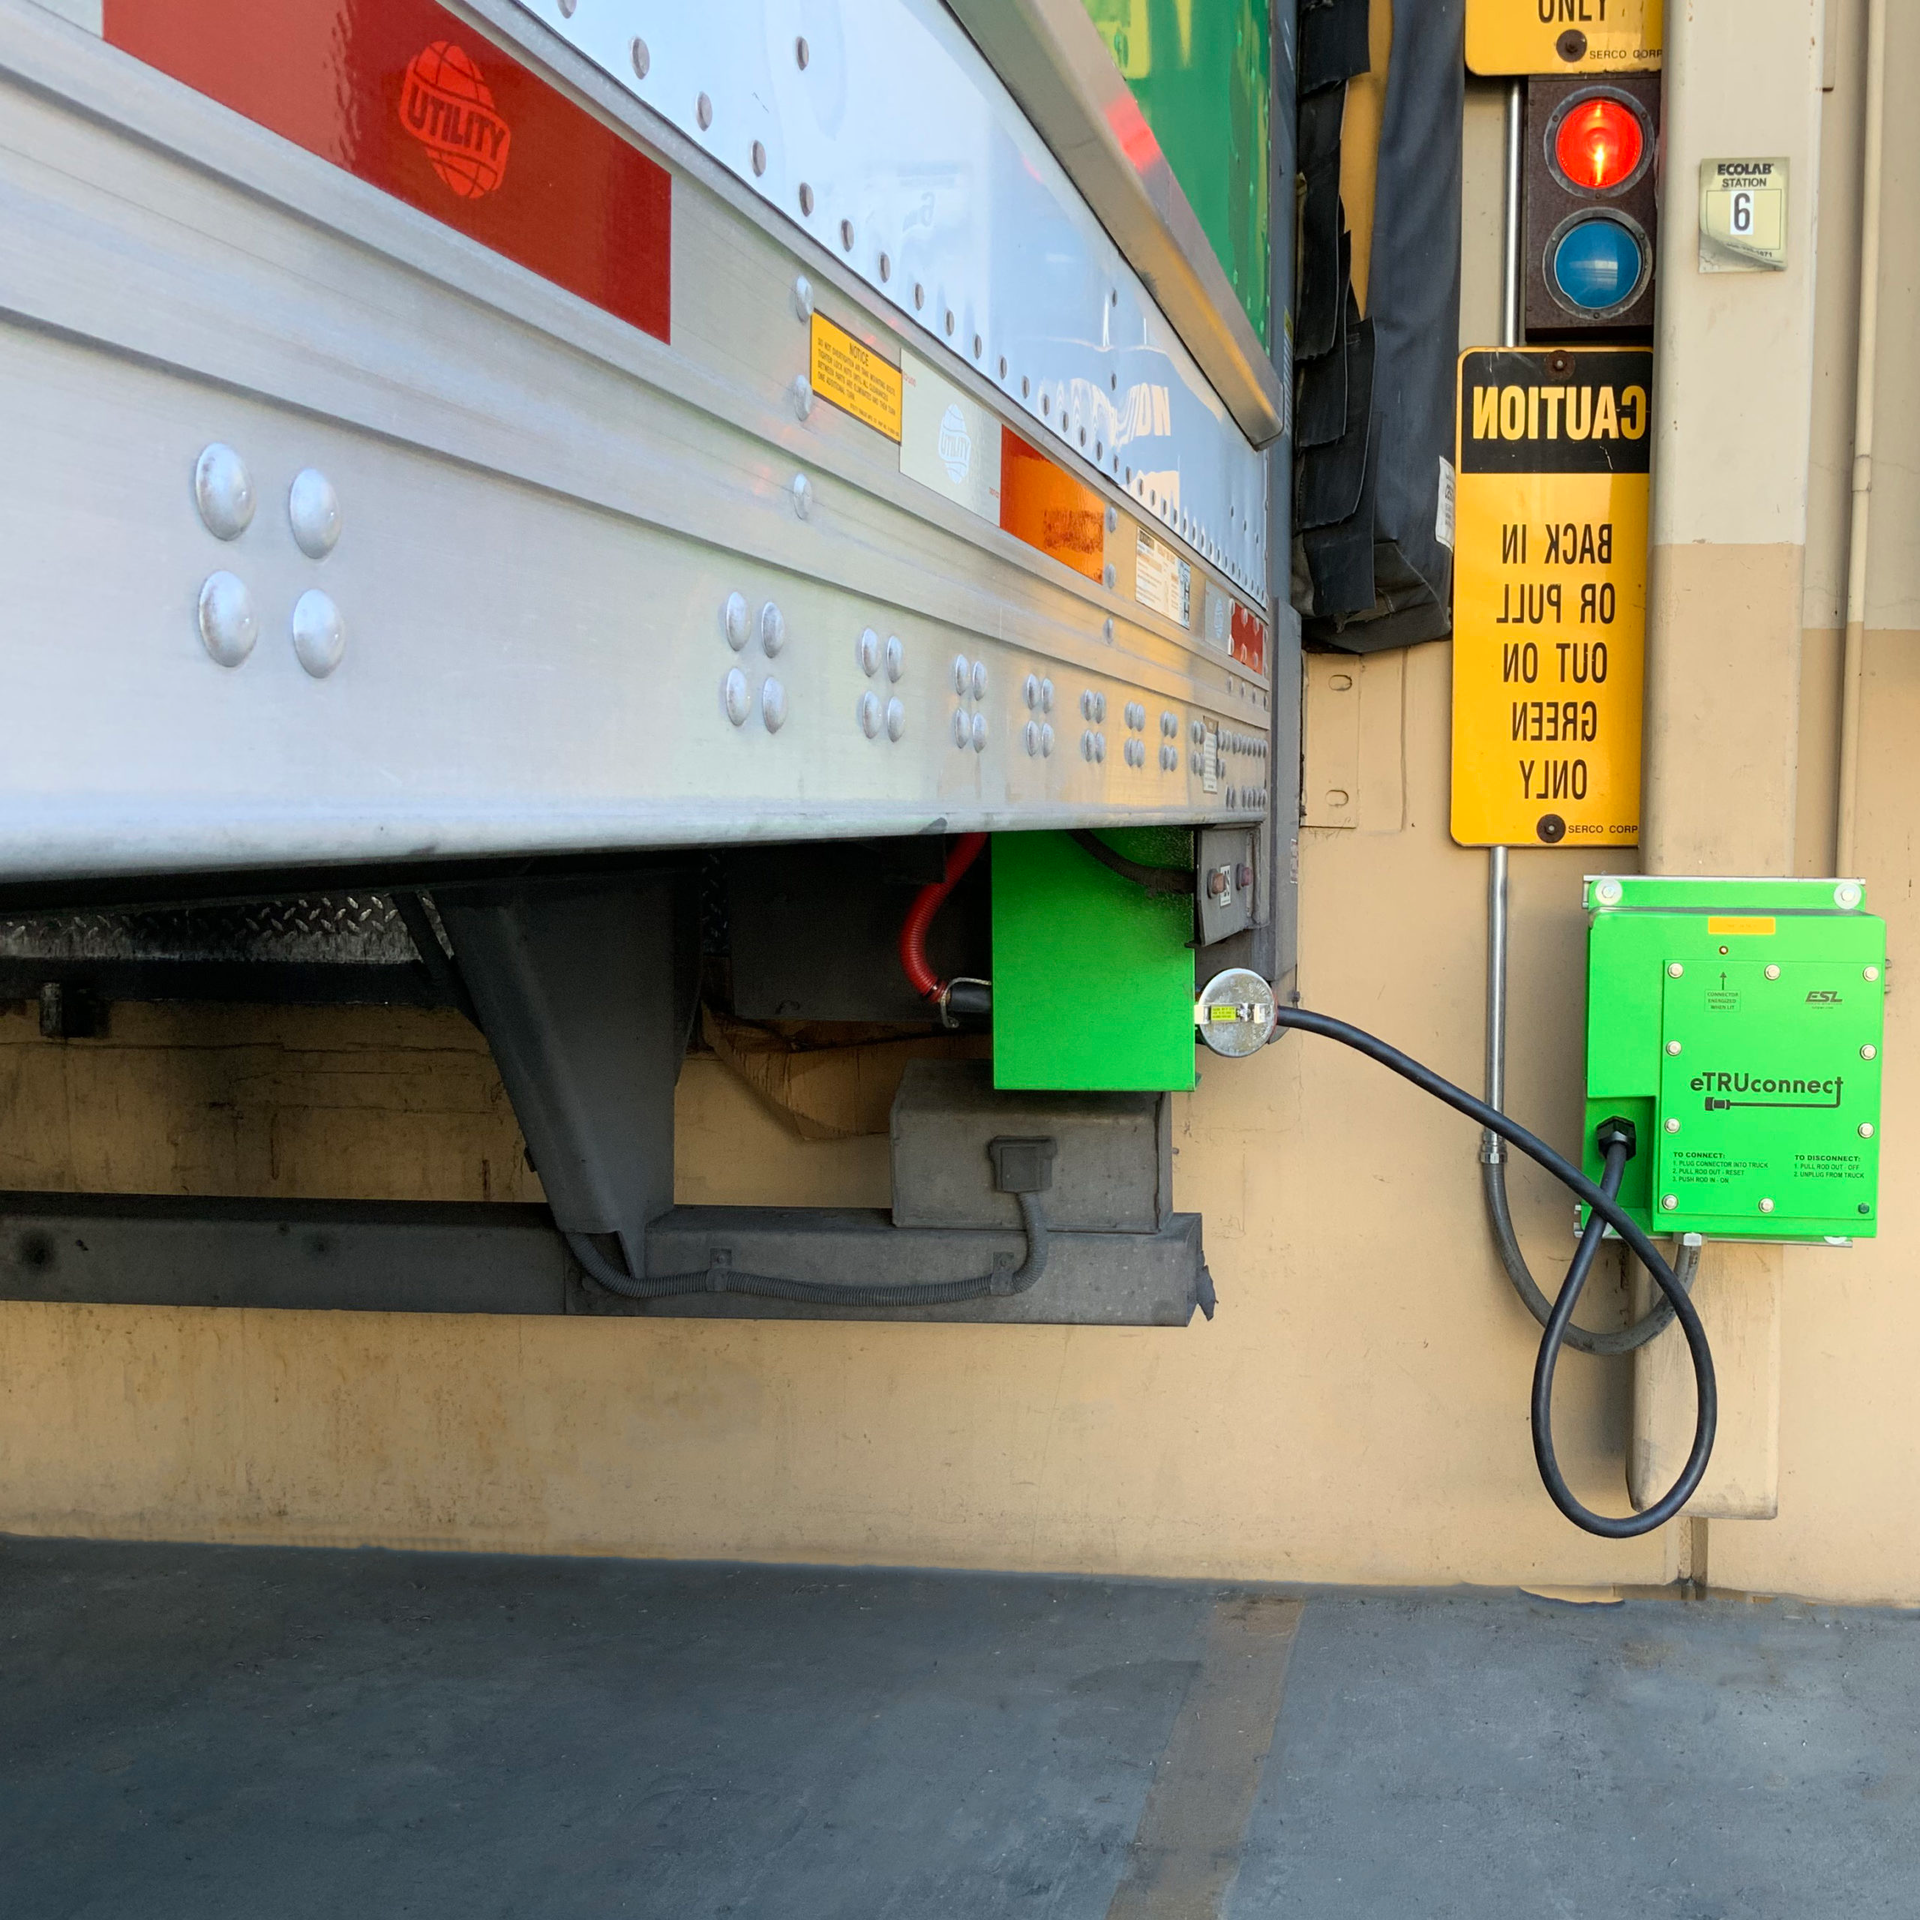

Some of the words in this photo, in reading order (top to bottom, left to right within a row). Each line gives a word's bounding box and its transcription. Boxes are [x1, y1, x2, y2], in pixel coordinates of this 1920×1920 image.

[1589, 50, 1627, 59] SERCO
[407, 81, 507, 162] UTILITY
[1717, 163, 1772, 176] ECOLAB
[1722, 178, 1767, 188] STATION
[1734, 193, 1750, 231] 6
[849, 343, 868, 367] NOTICE
[941, 431, 971, 461] UTILITY
[1568, 825, 1604, 834] SERCO
[1805, 991, 1843, 1002] ESL
[1690, 1072, 1843, 1094] eTRUconnect
